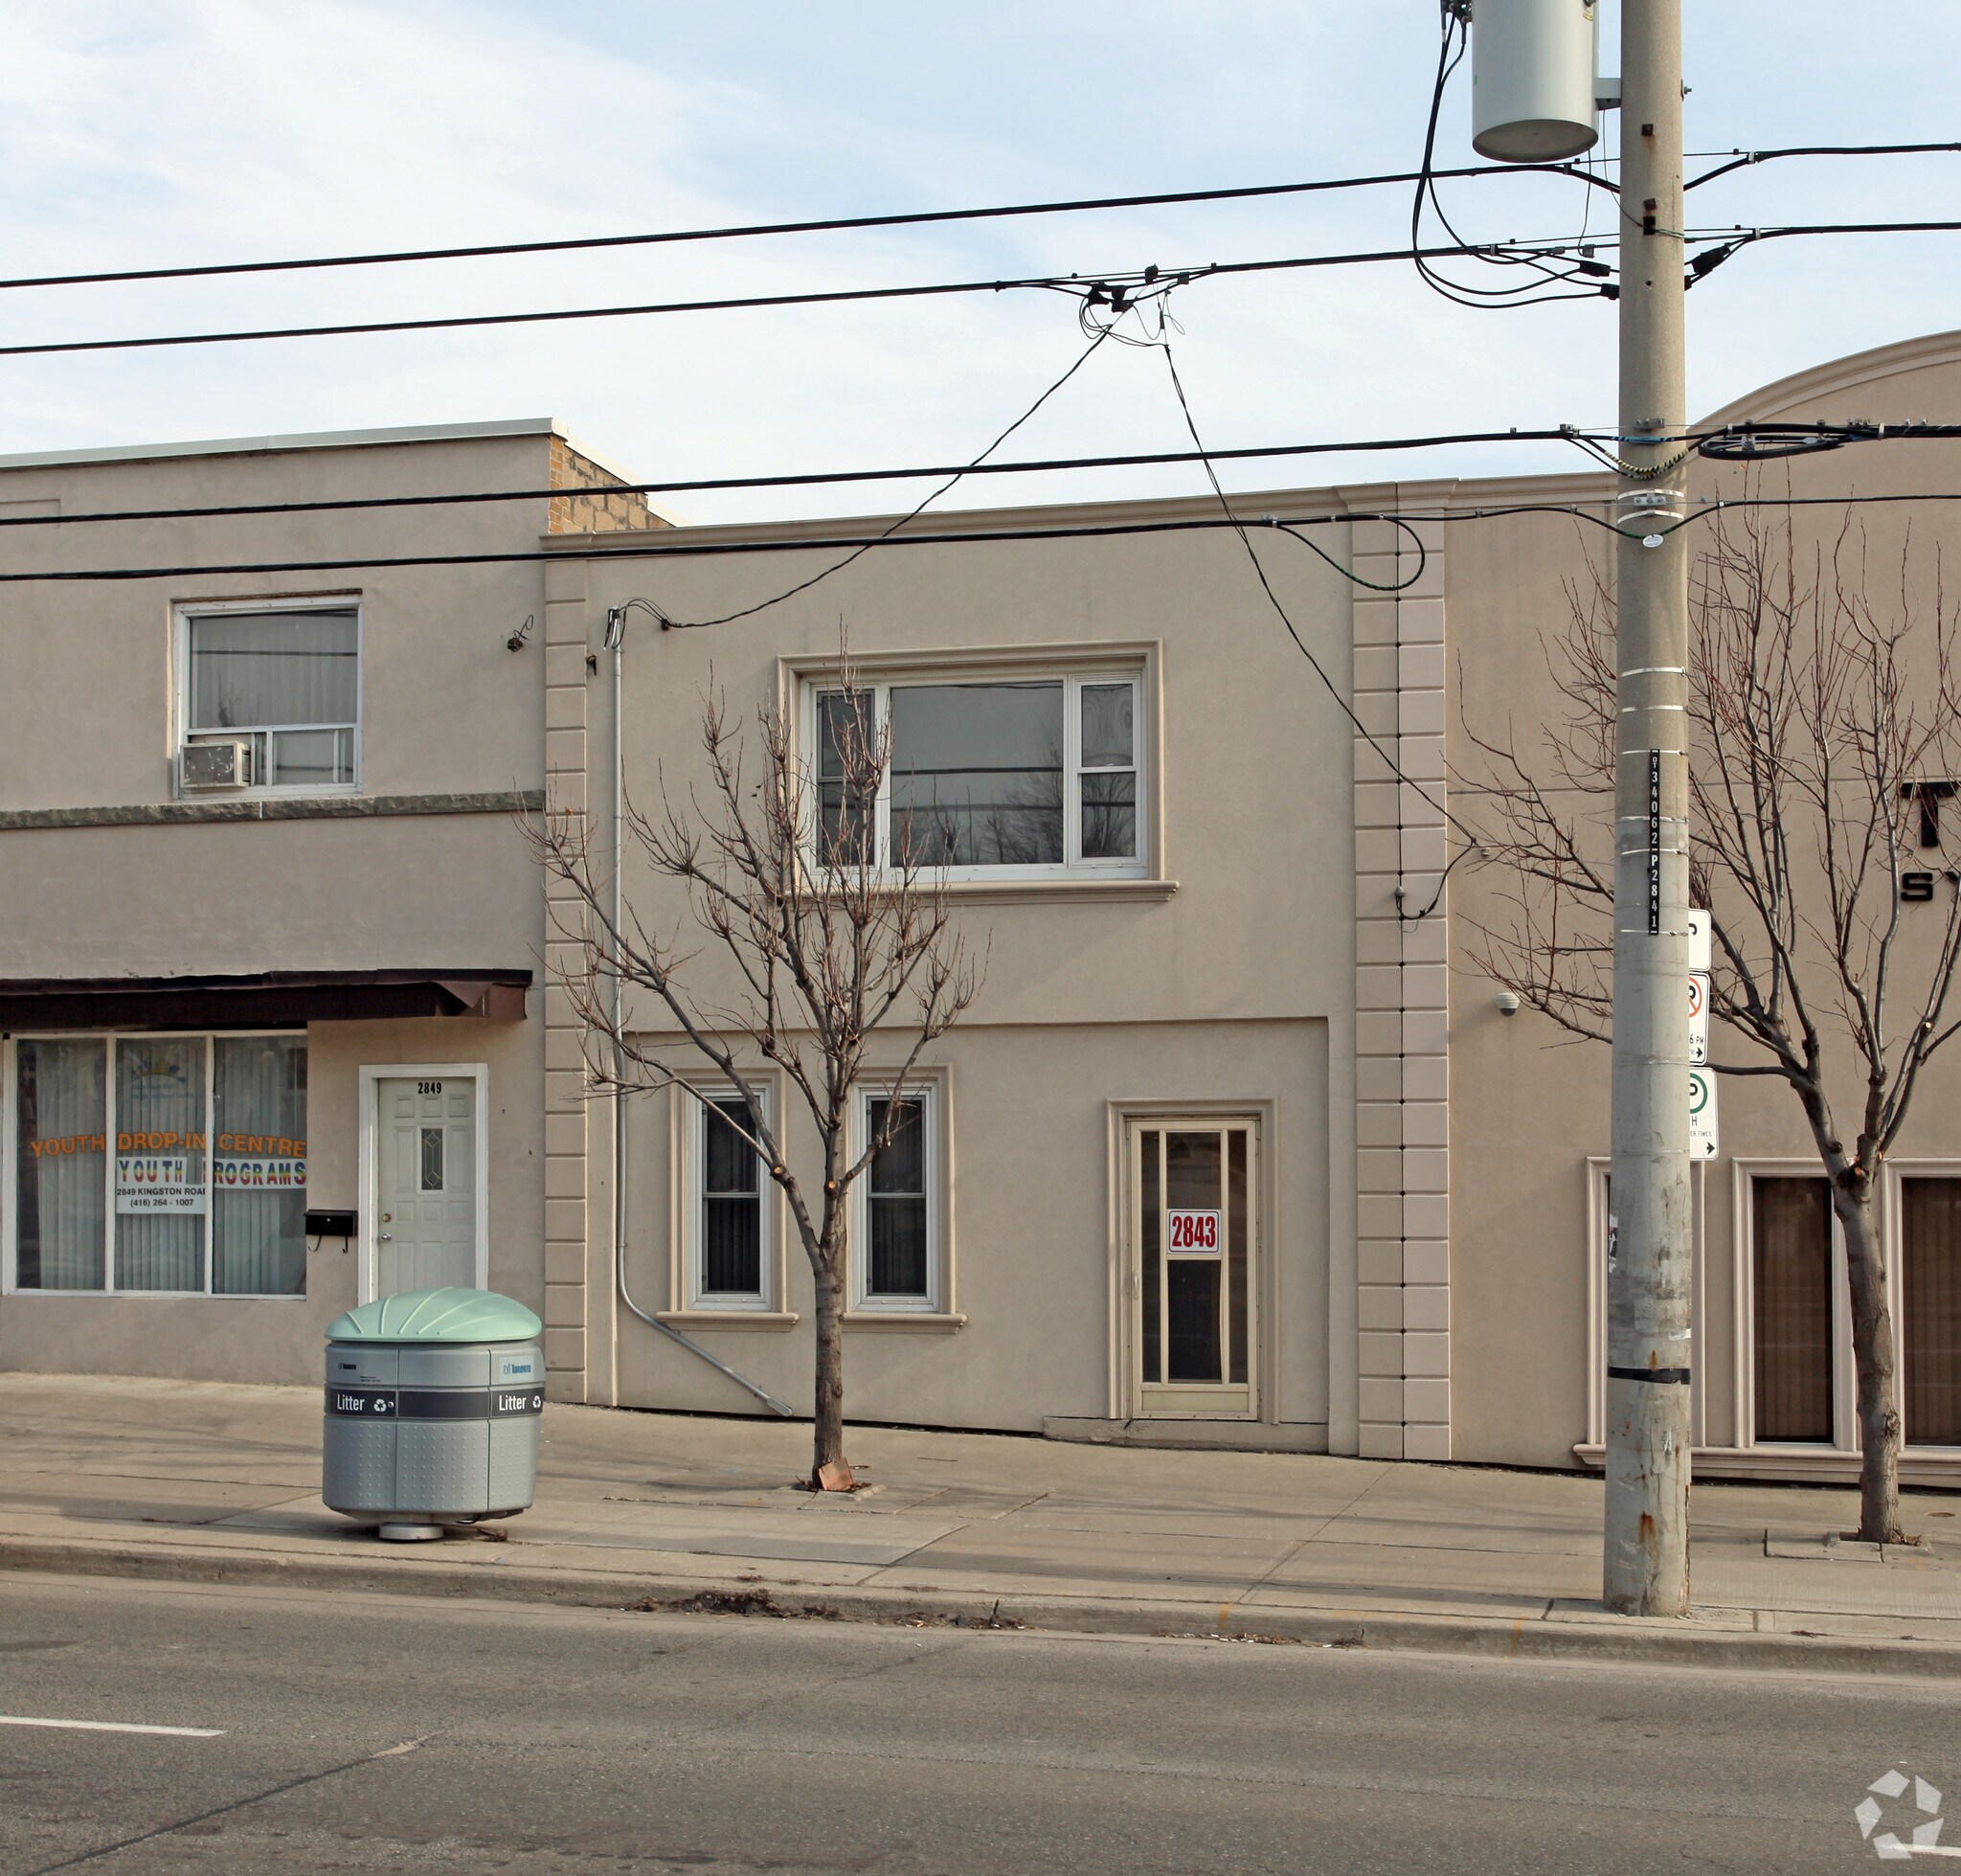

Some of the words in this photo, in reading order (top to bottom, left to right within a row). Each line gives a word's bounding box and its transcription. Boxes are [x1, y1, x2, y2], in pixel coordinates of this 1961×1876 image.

[417, 1082, 442, 1094] 2849
[30, 1133, 106, 1158] YOUTH
[117, 1131, 206, 1150] DROP-IN
[217, 1133, 306, 1158] CENTRE
[119, 1160, 183, 1183] YOUTH
[203, 1161, 306, 1186] ROGRAMS
[117, 1187, 136, 1196] 2849
[138, 1187, 182, 1196] KINGSTON
[130, 1198, 150, 1208] (416)
[153, 1198, 168, 1207] 264
[175, 1198, 194, 1207] 1007
[1172, 1215, 1216, 1248] 2843
[337, 1393, 365, 1411] Litter
[499, 1394, 527, 1411] Litter
